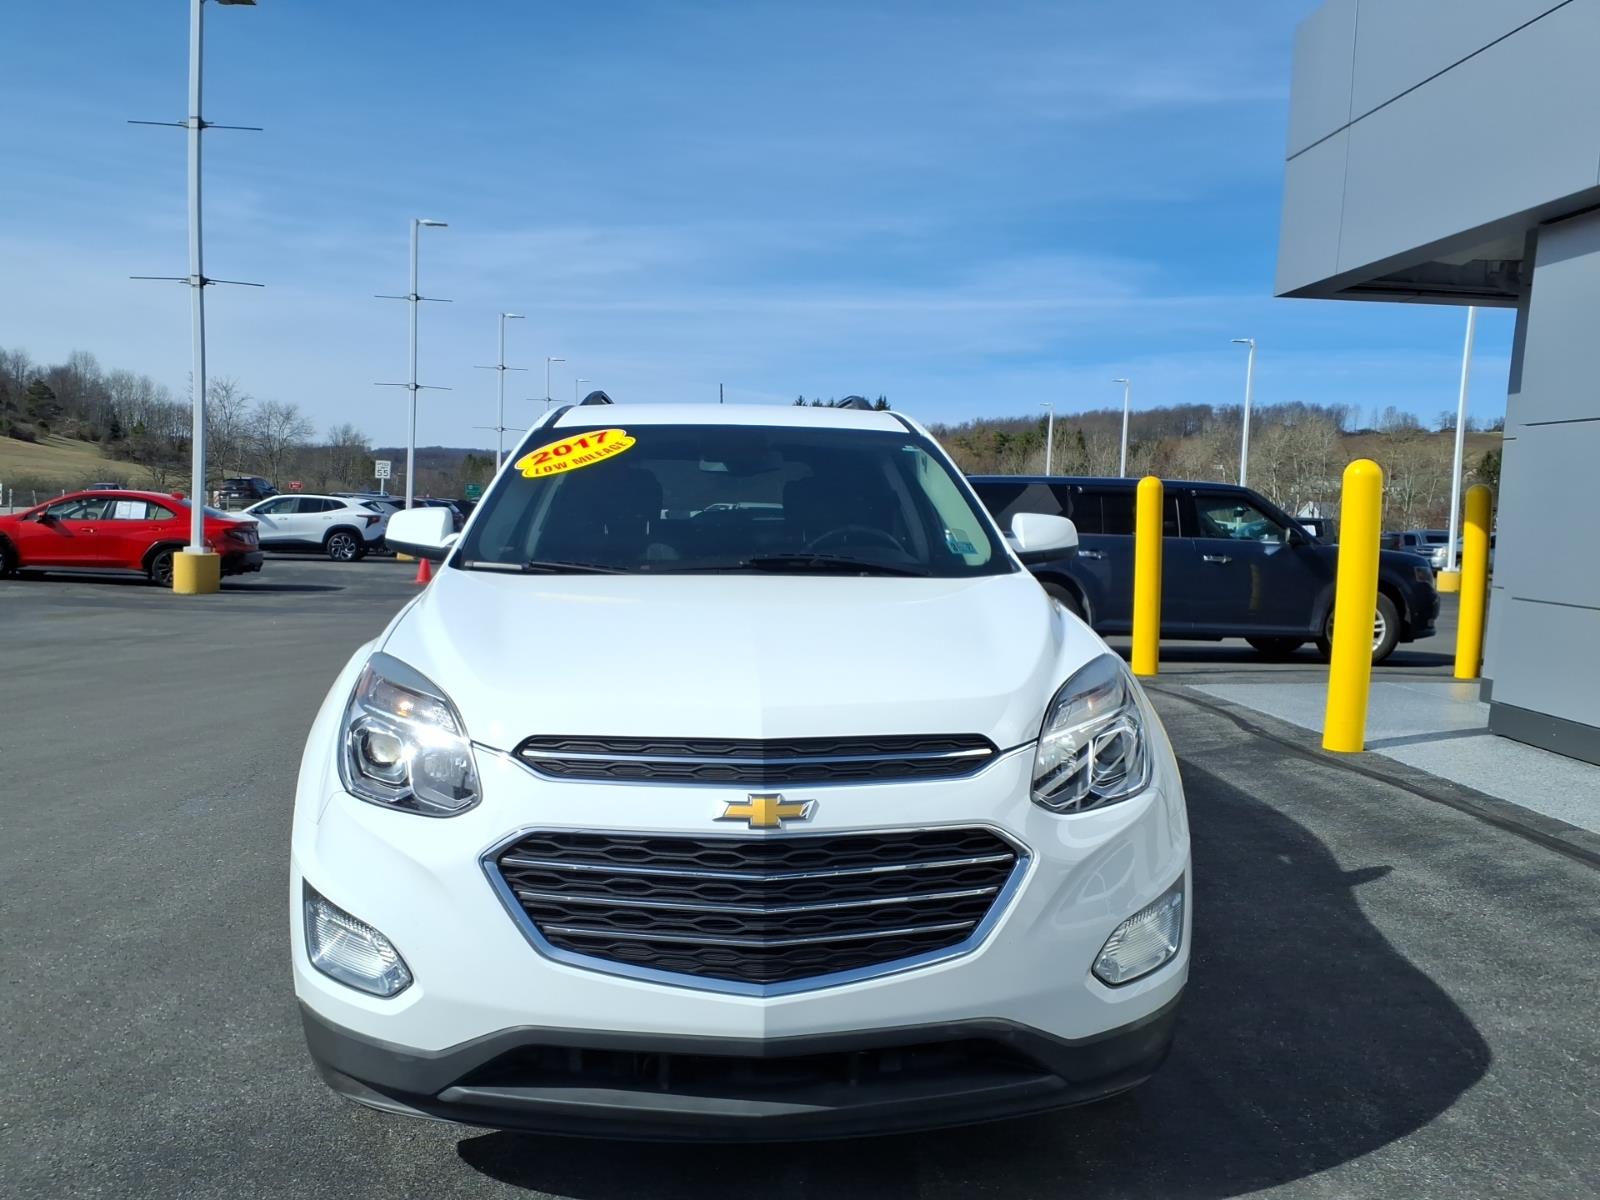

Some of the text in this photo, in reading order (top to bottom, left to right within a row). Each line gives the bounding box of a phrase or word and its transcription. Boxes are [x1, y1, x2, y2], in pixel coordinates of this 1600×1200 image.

[531, 431, 607, 465] 2017
[535, 441, 626, 474] LOW MILEAGE
